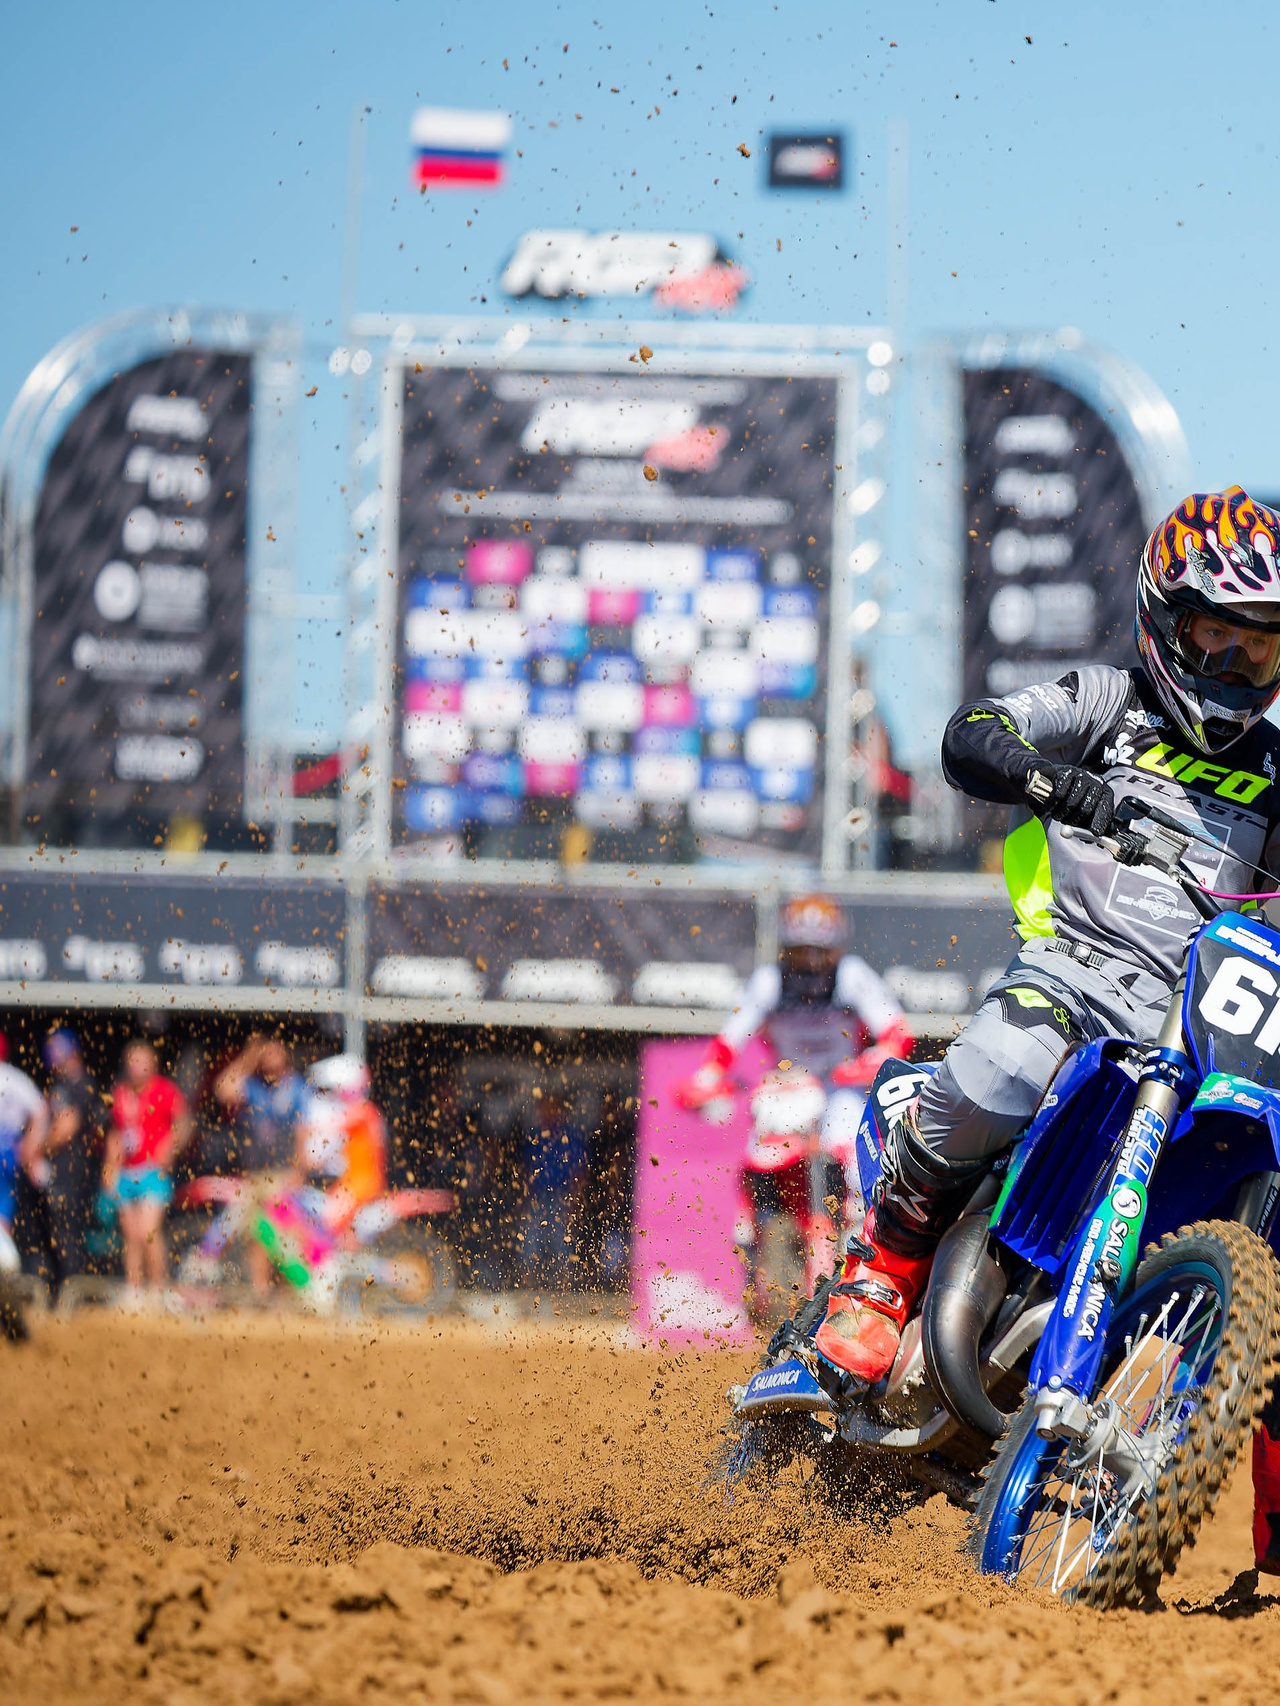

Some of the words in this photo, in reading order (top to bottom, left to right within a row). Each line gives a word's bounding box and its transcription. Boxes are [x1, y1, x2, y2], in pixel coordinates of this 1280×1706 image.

[1126, 774, 1253, 822] PLAST
[1135, 742, 1271, 804] UFO
[877, 1073, 931, 1130] 61
[1115, 1106, 1146, 1174] RACING
[1077, 1216, 1129, 1341] SALNICA
[751, 1369, 801, 1392] SALMONICA
